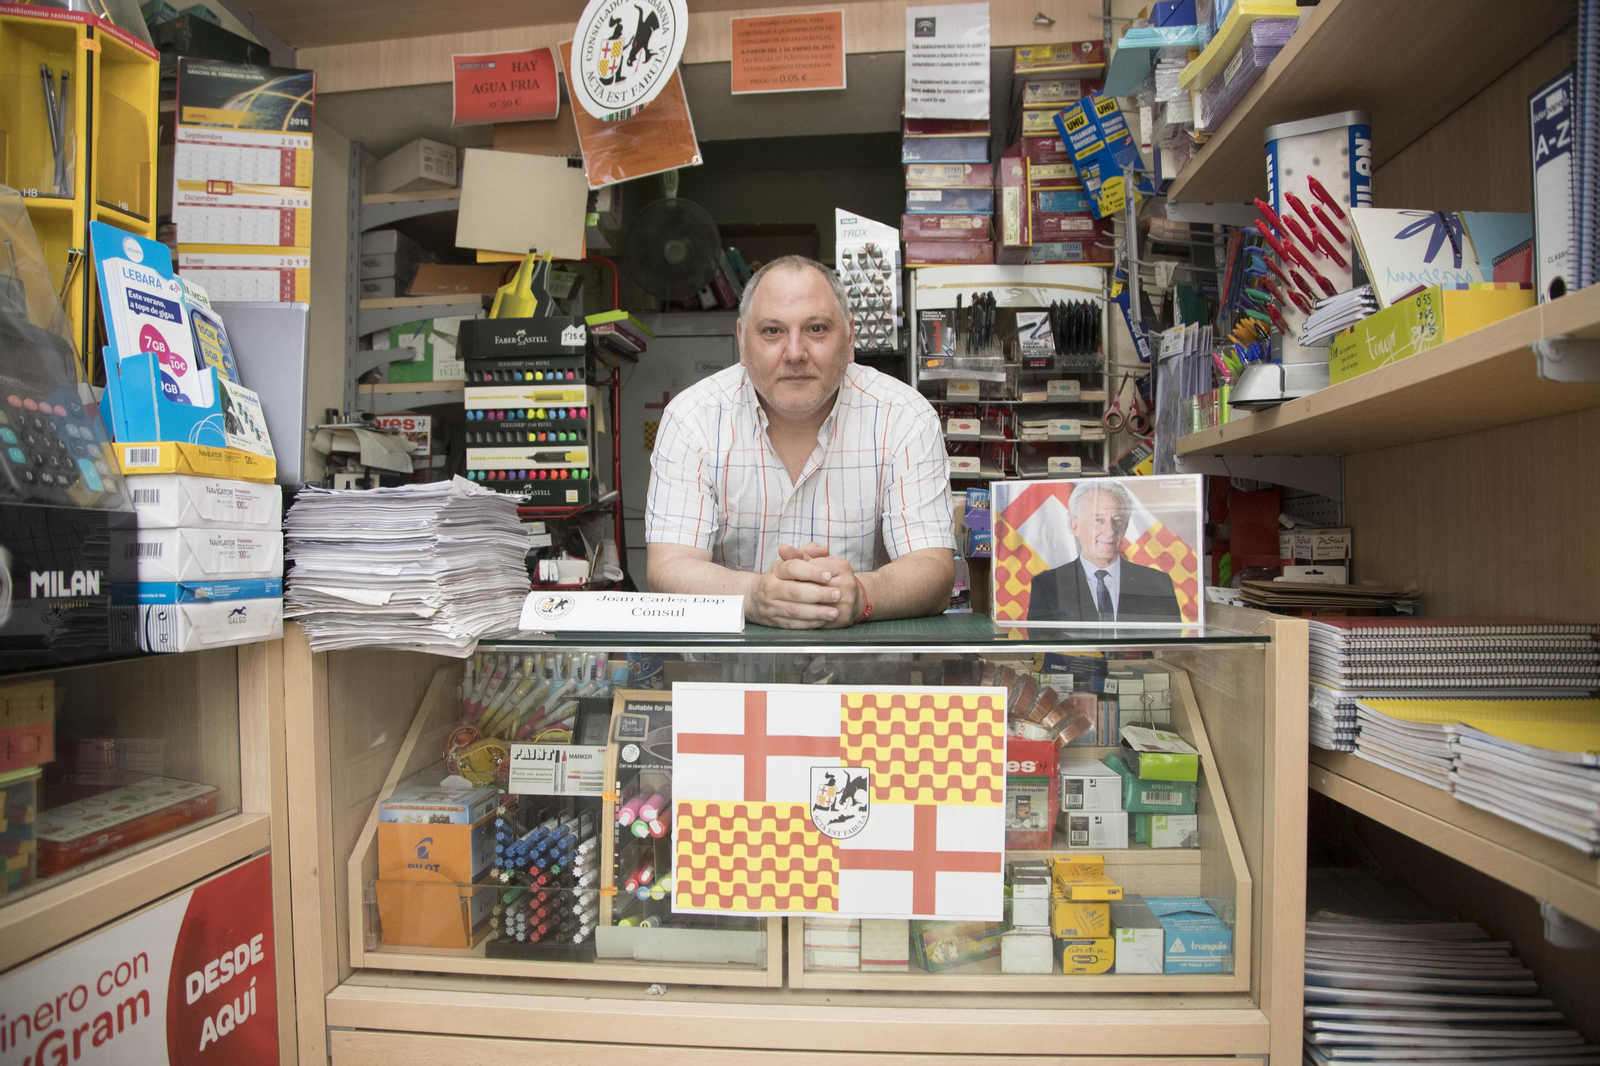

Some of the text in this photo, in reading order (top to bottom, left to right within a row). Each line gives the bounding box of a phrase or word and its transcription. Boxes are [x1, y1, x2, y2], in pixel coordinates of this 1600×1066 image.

[51, 12, 85, 22] resistente
[512, 60, 538, 73] HAY
[586, 44, 668, 104] ACTA EST FABULA
[472, 79, 540, 94] AGUA FRIA
[515, 98, 522, 106] €
[1097, 101, 1115, 116] UHU
[290, 117, 309, 126] 2016
[1066, 116, 1084, 132] UHU
[184, 132, 223, 141] Septiembre
[1070, 124, 1097, 144] PEGAMENTO
[1535, 118, 1571, 162] A-Z
[1073, 133, 1098, 151] UNIVERSAL
[23, 188, 38, 198] HB
[184, 194, 218, 203] Diciembre
[118, 200, 129, 212] HB
[843, 229, 868, 238] TROX
[185, 257, 205, 265] Enero
[122, 266, 163, 290] LEBARA
[169, 284, 178, 293] 4G
[128, 290, 166, 309] Este verano,
[135, 303, 150, 315] tope
[150, 306, 159, 315] de
[579, 332, 586, 341] €
[144, 336, 166, 353] 7GB
[170, 361, 187, 371] 10€
[198, 449, 223, 459] NAVIGATOR
[206, 486, 233, 496] NAVIGATOR
[236, 500, 244, 509] 100
[209, 538, 235, 547] NAVIGATOR
[238, 550, 246, 559] 100
[30, 570, 100, 599] MILAN
[693, 597, 725, 605] Llop
[631, 607, 685, 617] Cónsul
[228, 616, 247, 625] GALGO
[627, 704, 653, 712] Suitable
[513, 748, 555, 761] PAINT
[813, 814, 867, 837] ACTA EST FABULA
[1190, 940, 1227, 952] triangulo
[97, 951, 149, 997] con
[186, 932, 265, 1006] DESDE
[199, 976, 257, 1052] AQUÍ
[22, 988, 151, 1066] Gram
